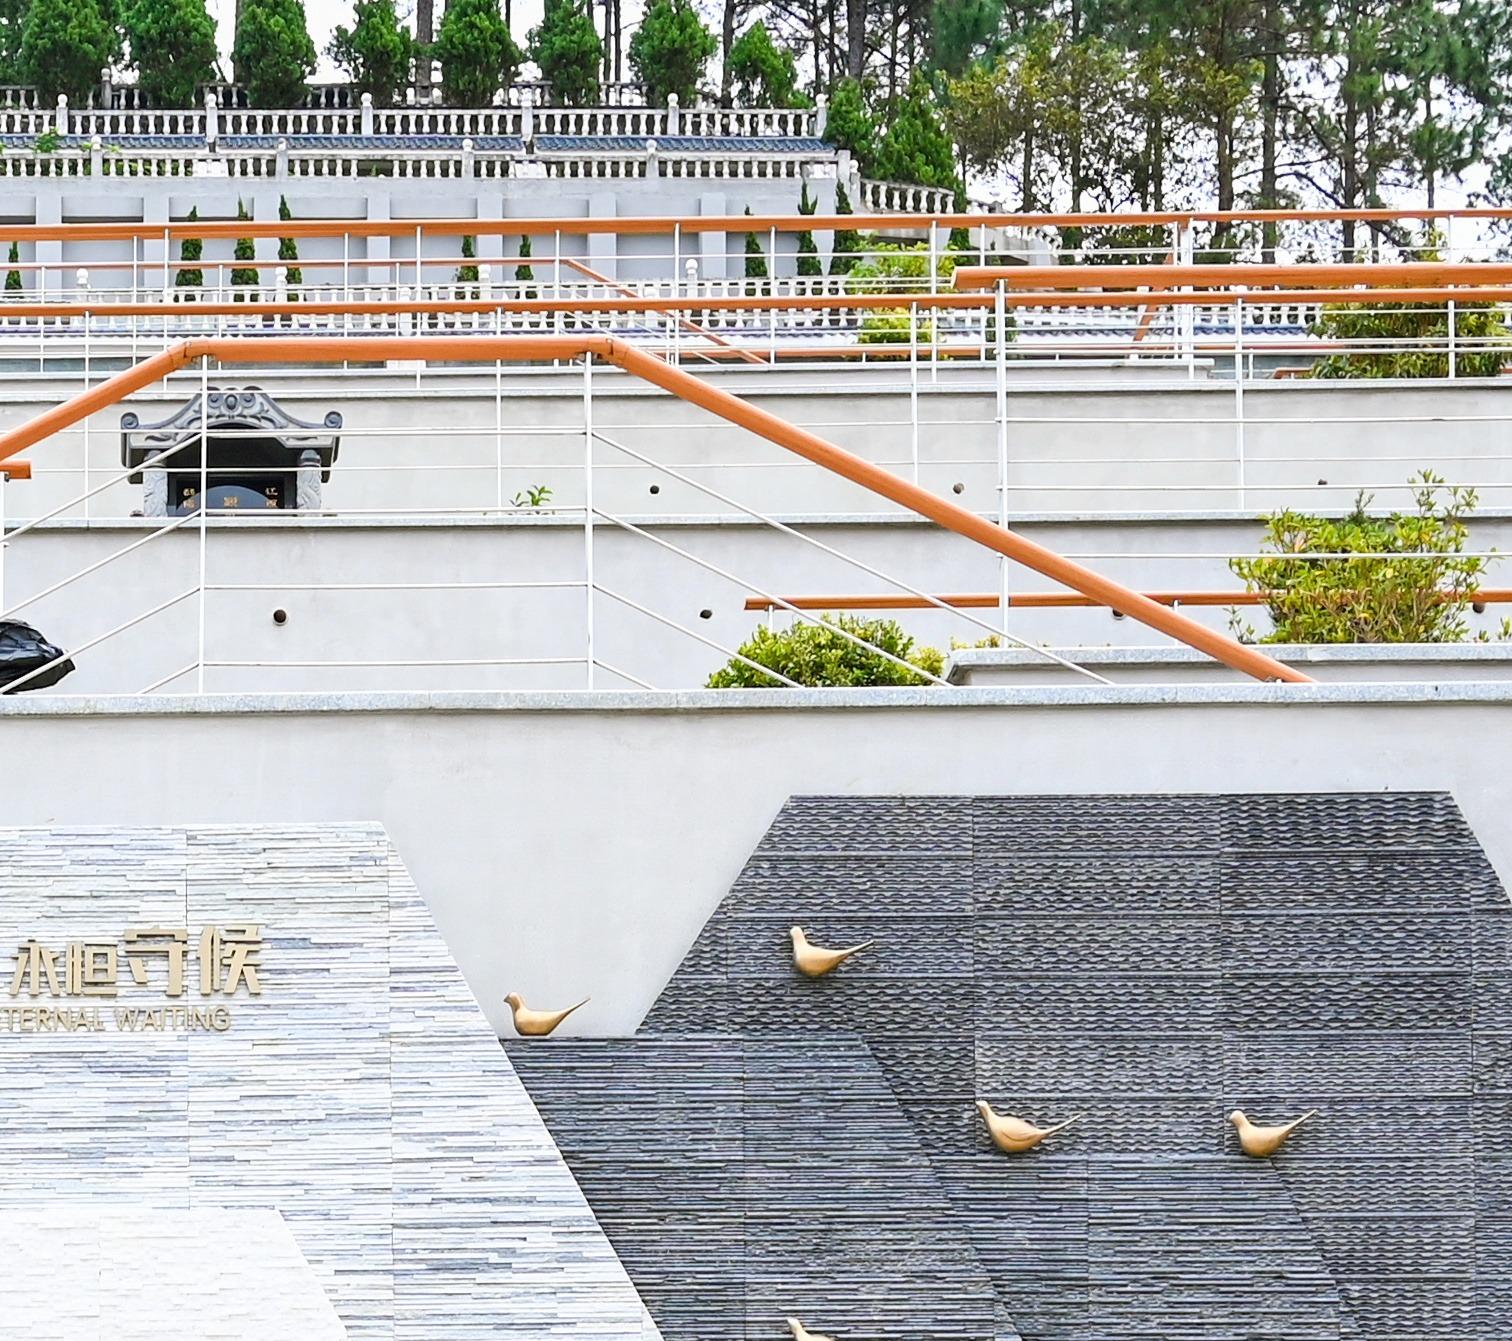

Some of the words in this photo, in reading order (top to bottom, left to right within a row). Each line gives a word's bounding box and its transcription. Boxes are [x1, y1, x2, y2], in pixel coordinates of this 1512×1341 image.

[9, 924, 264, 997] 永恒守候
[114, 1005, 233, 1033] WAITING
